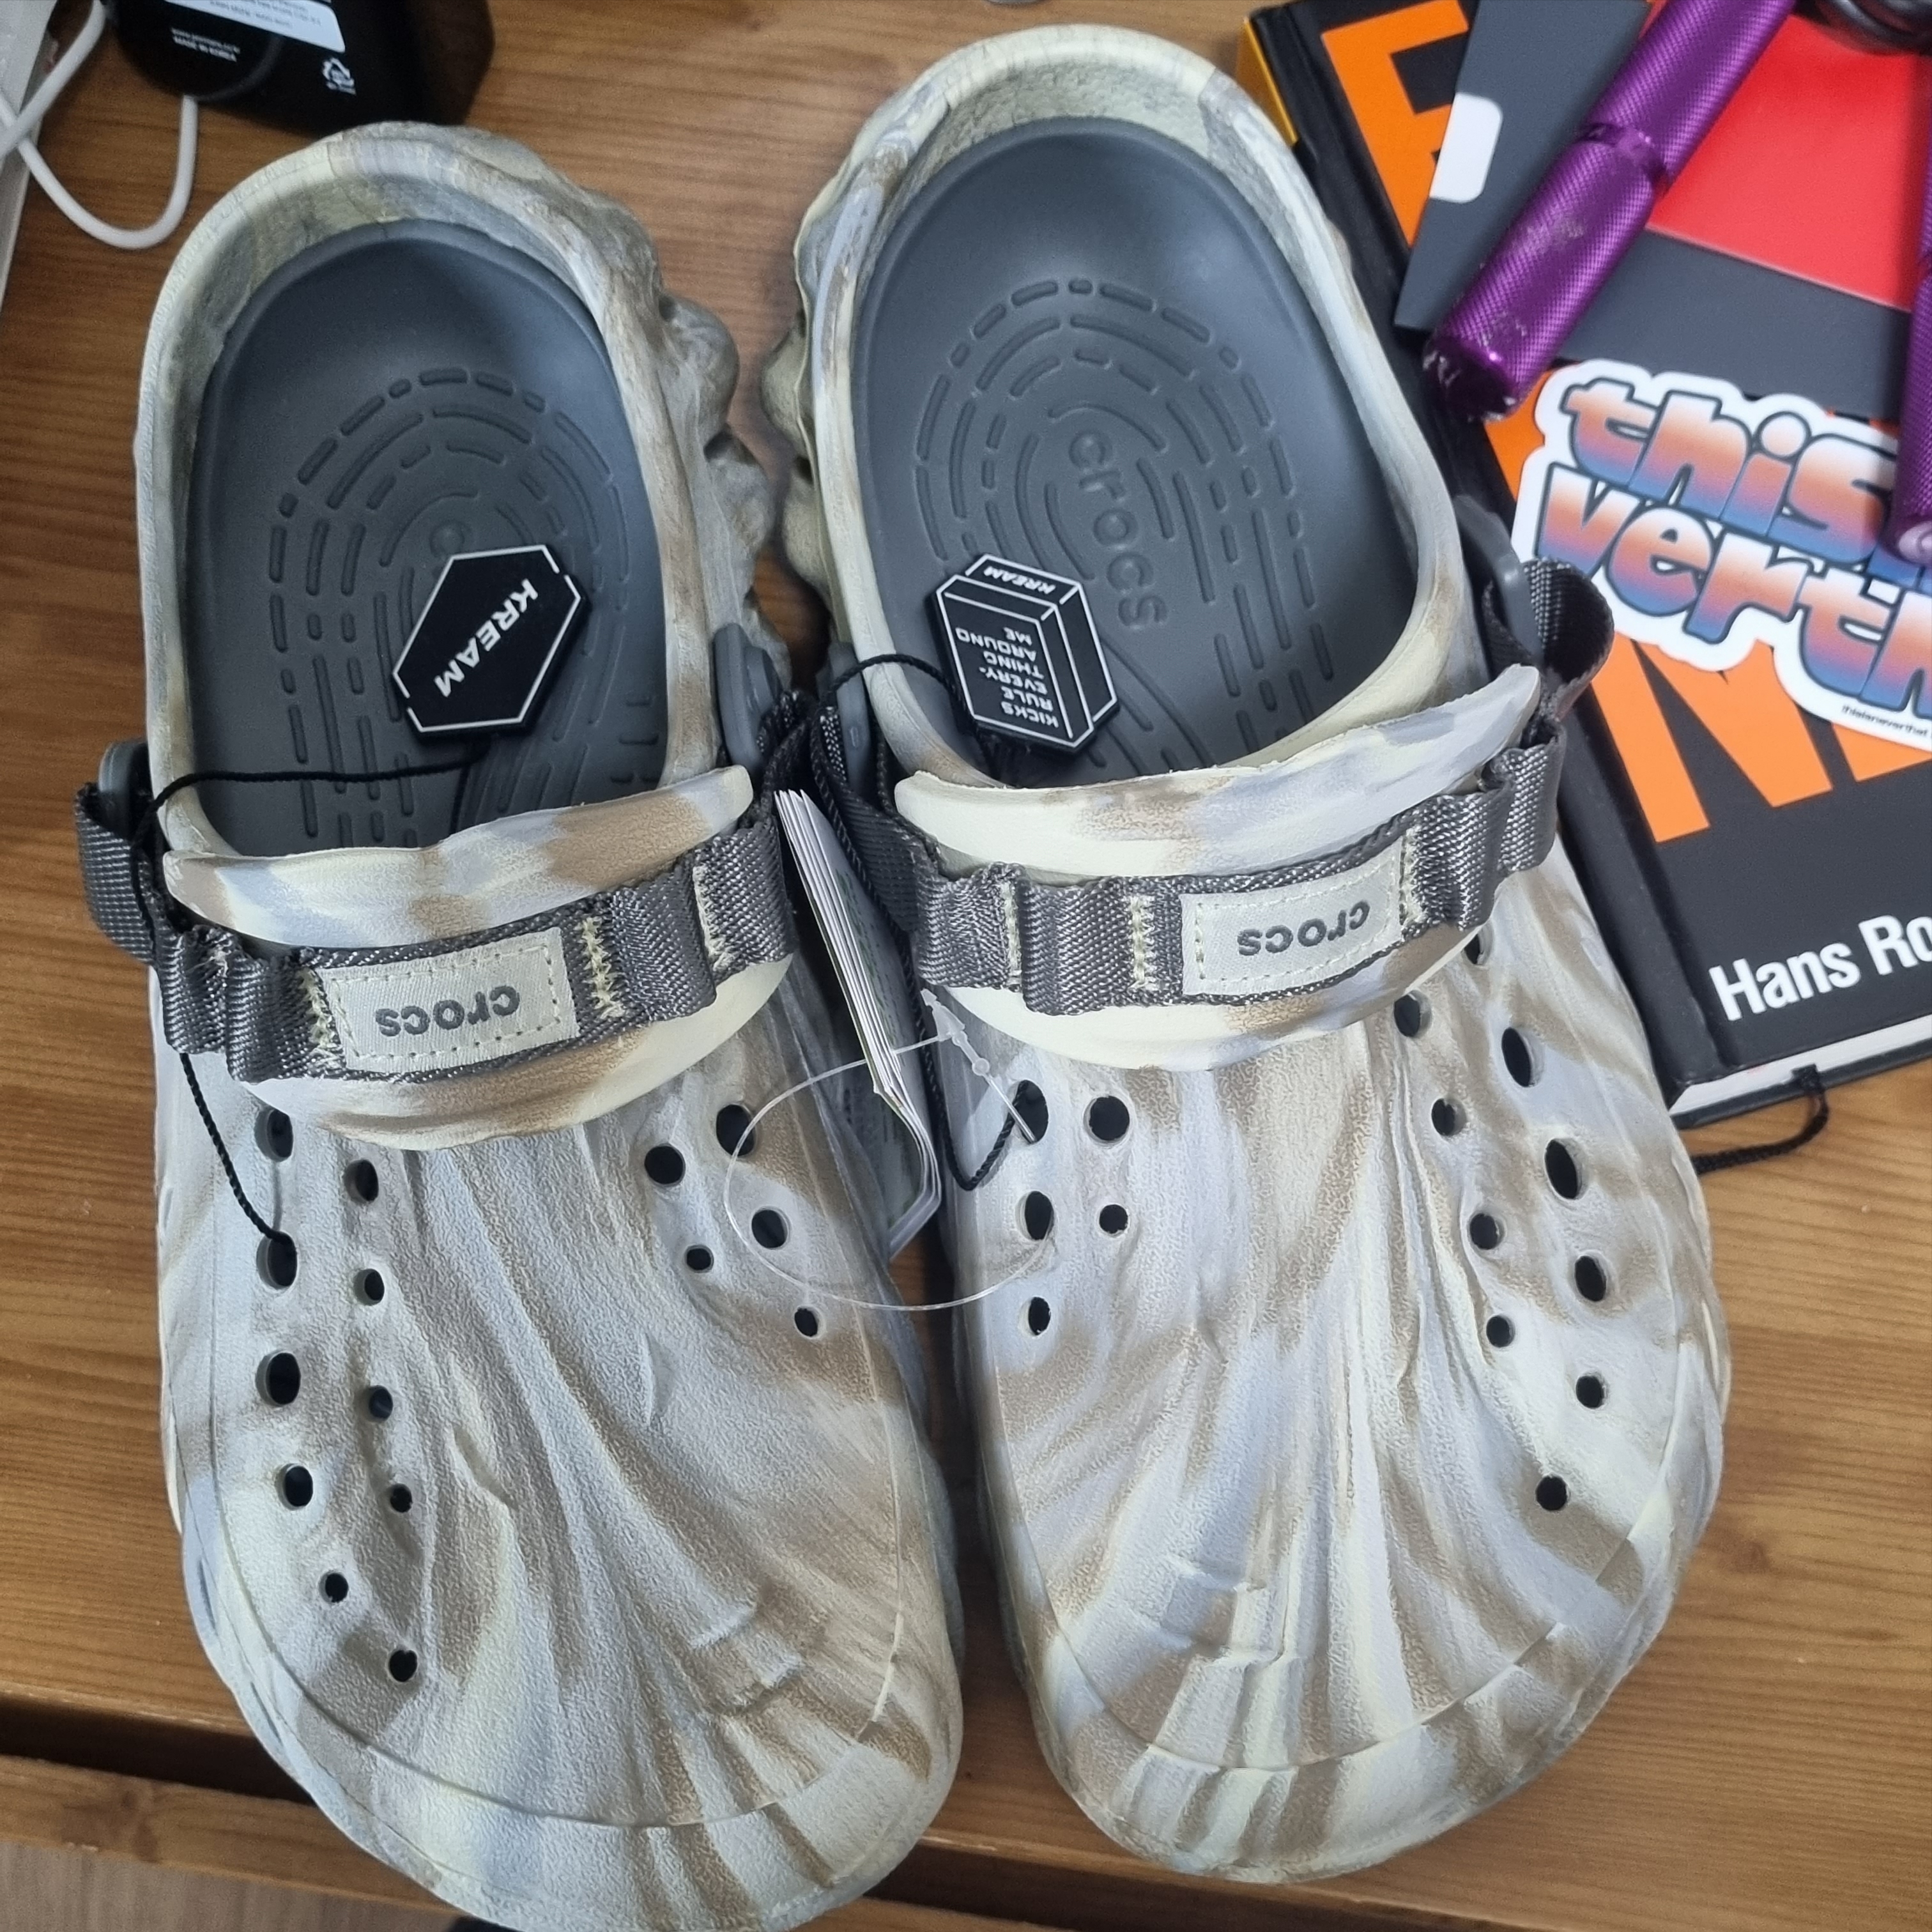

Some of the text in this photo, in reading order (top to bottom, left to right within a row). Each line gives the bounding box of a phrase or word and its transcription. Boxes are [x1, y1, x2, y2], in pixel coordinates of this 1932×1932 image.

[1068, 429, 1168, 629] crocs
[983, 566, 1056, 594] KREAM
[433, 578, 538, 697] KREAM
[955, 627, 1037, 661] AROUND
[1003, 627, 1032, 646] ME
[983, 650, 1044, 679] THING
[979, 666, 1048, 695] EVERY-
[1001, 686, 1054, 712] RULE
[1001, 702, 1059, 728] KICKS
[1237, 900, 1370, 956] crocs
[1708, 942, 1861, 1022] Hans
[375, 985, 520, 1037] crocs
